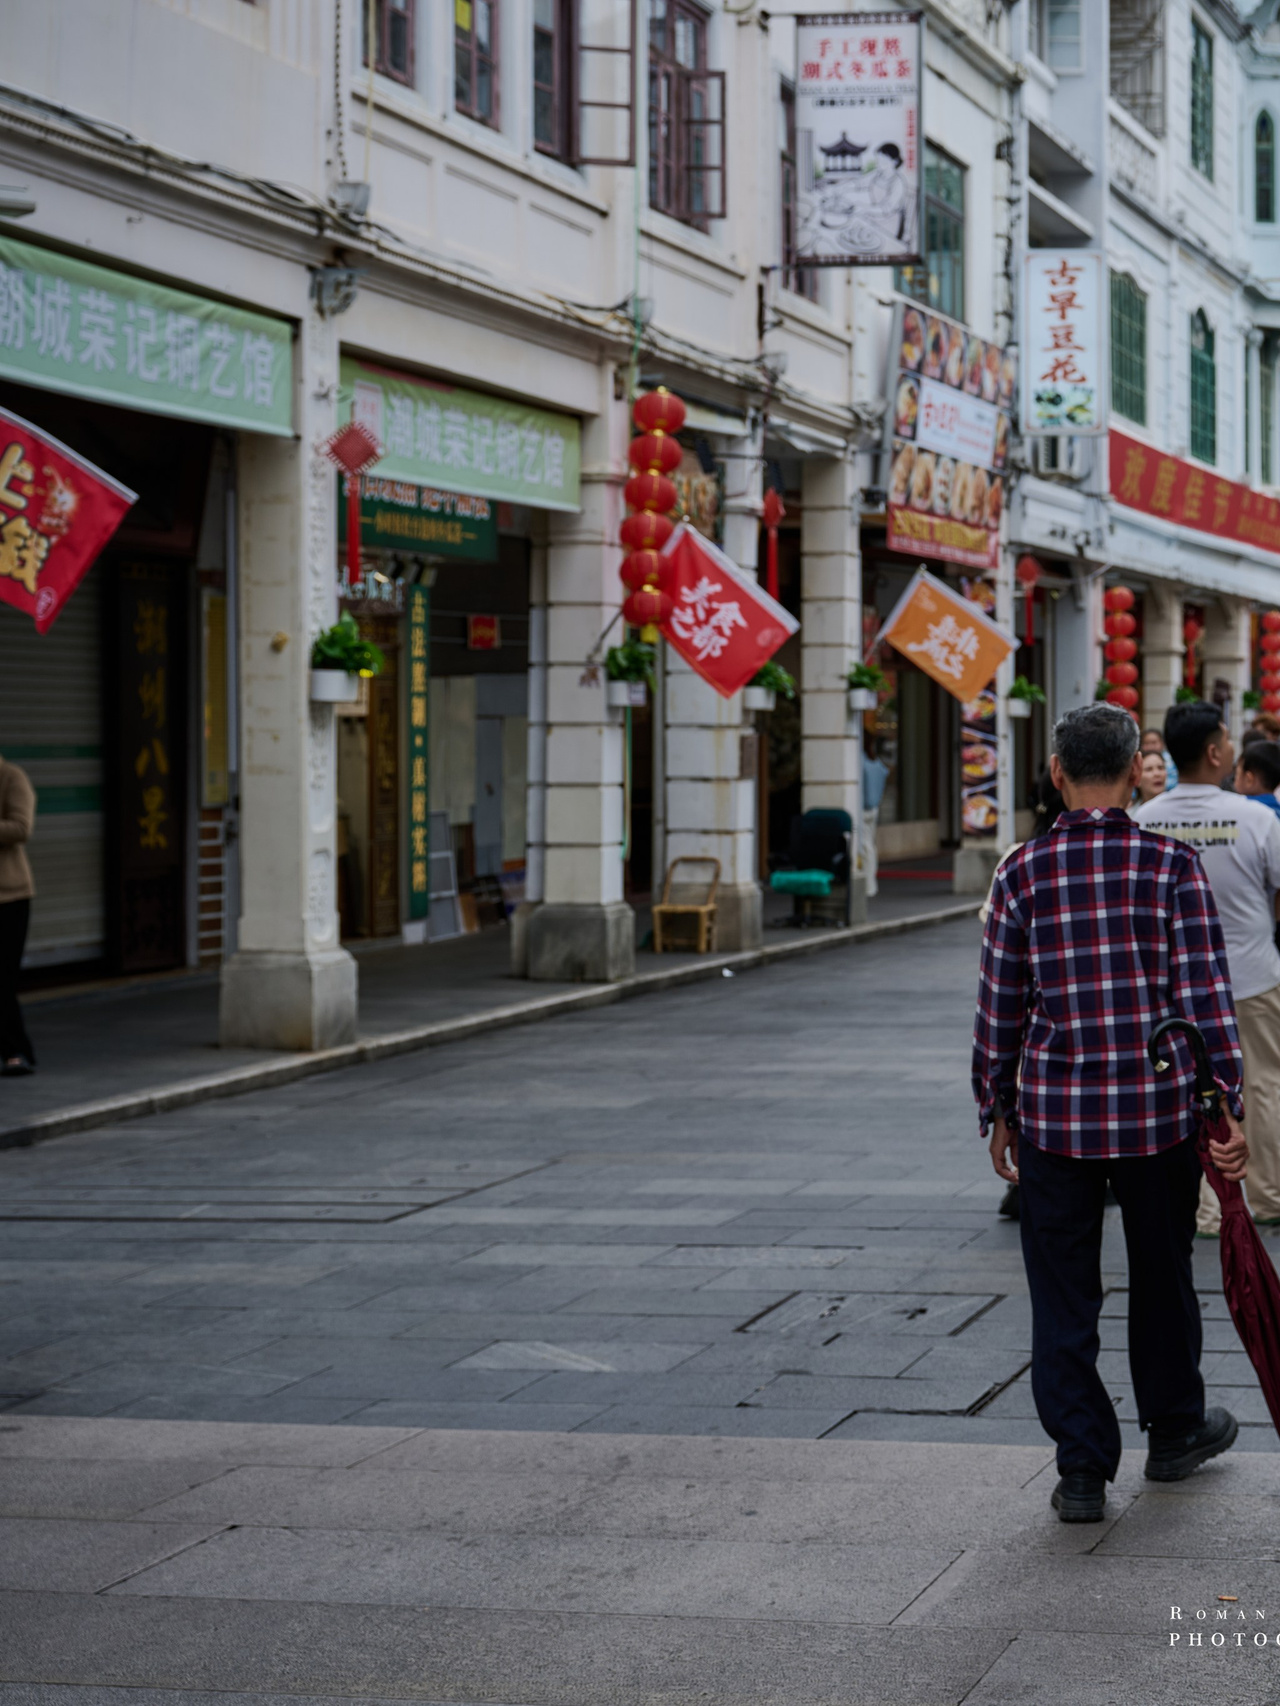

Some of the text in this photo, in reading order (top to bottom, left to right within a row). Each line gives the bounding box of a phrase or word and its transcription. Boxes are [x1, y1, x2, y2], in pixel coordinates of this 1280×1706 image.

[1040, 259, 1086, 385] 古早豆花
[1119, 446, 1233, 529] 欢度佳节
